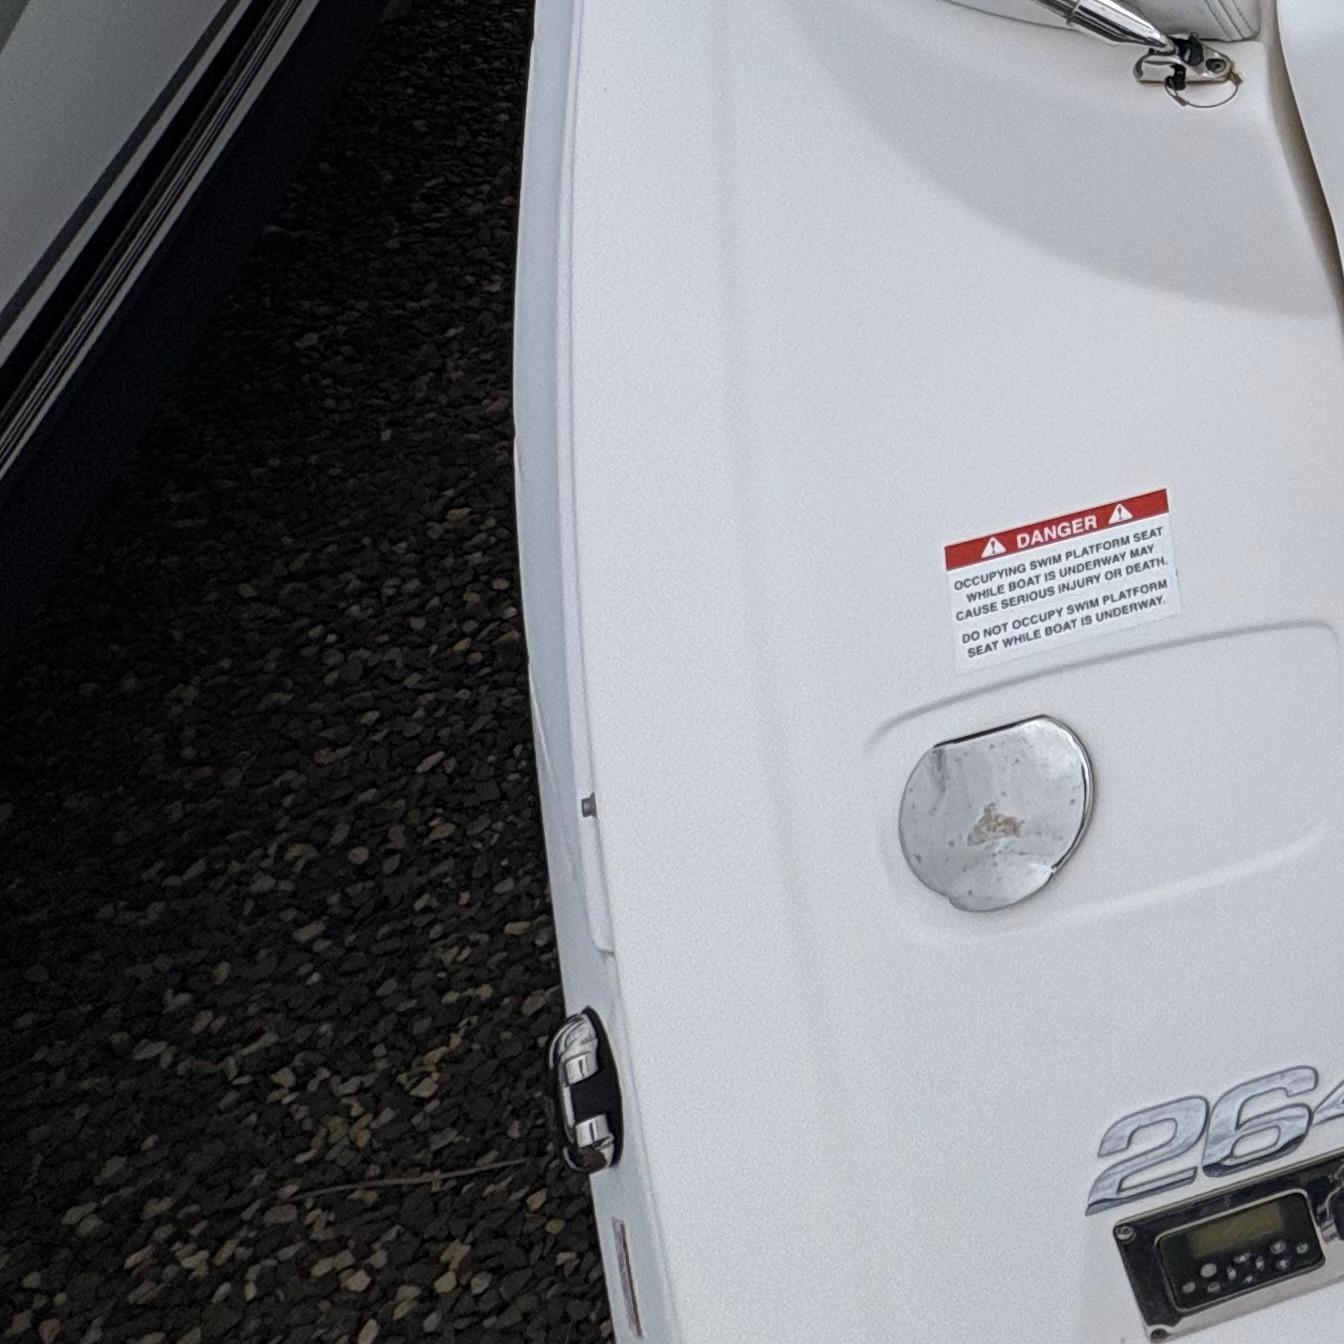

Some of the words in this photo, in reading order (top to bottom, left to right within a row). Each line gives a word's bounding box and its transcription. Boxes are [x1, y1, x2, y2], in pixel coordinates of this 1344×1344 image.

[954, 563, 1026, 591] OCCUPYING
[1030, 554, 1062, 570] SWIM
[1065, 536, 1131, 560] PLATFORM
[1133, 526, 1163, 542] SEAT
[1016, 515, 1098, 549] DANGER
[955, 602, 998, 622] CAUSE
[1001, 586, 1056, 610] SERIOUS
[1058, 573, 1101, 594] INJURY
[1104, 568, 1123, 581] OR
[1125, 556, 1168, 575] DEATH.
[966, 584, 1005, 603] WHILE
[1008, 575, 1041, 592] BOAT
[1044, 570, 1056, 582] IS
[1059, 551, 1127, 578] UNDERWAY
[1130, 543, 1155, 559] MAY
[962, 630, 981, 644] DO
[983, 622, 1009, 638] NOT
[1012, 607, 1064, 630] OCCUPY
[1066, 598, 1100, 615] SWIM
[1102, 579, 1168, 605] PLATFORM
[967, 640, 999, 659] SEAT
[1002, 629, 1042, 648] WHILE
[1044, 618, 1078, 636] BOAT
[1080, 615, 1093, 626] IS
[1095, 595, 1166, 623] UNDERWAY.
